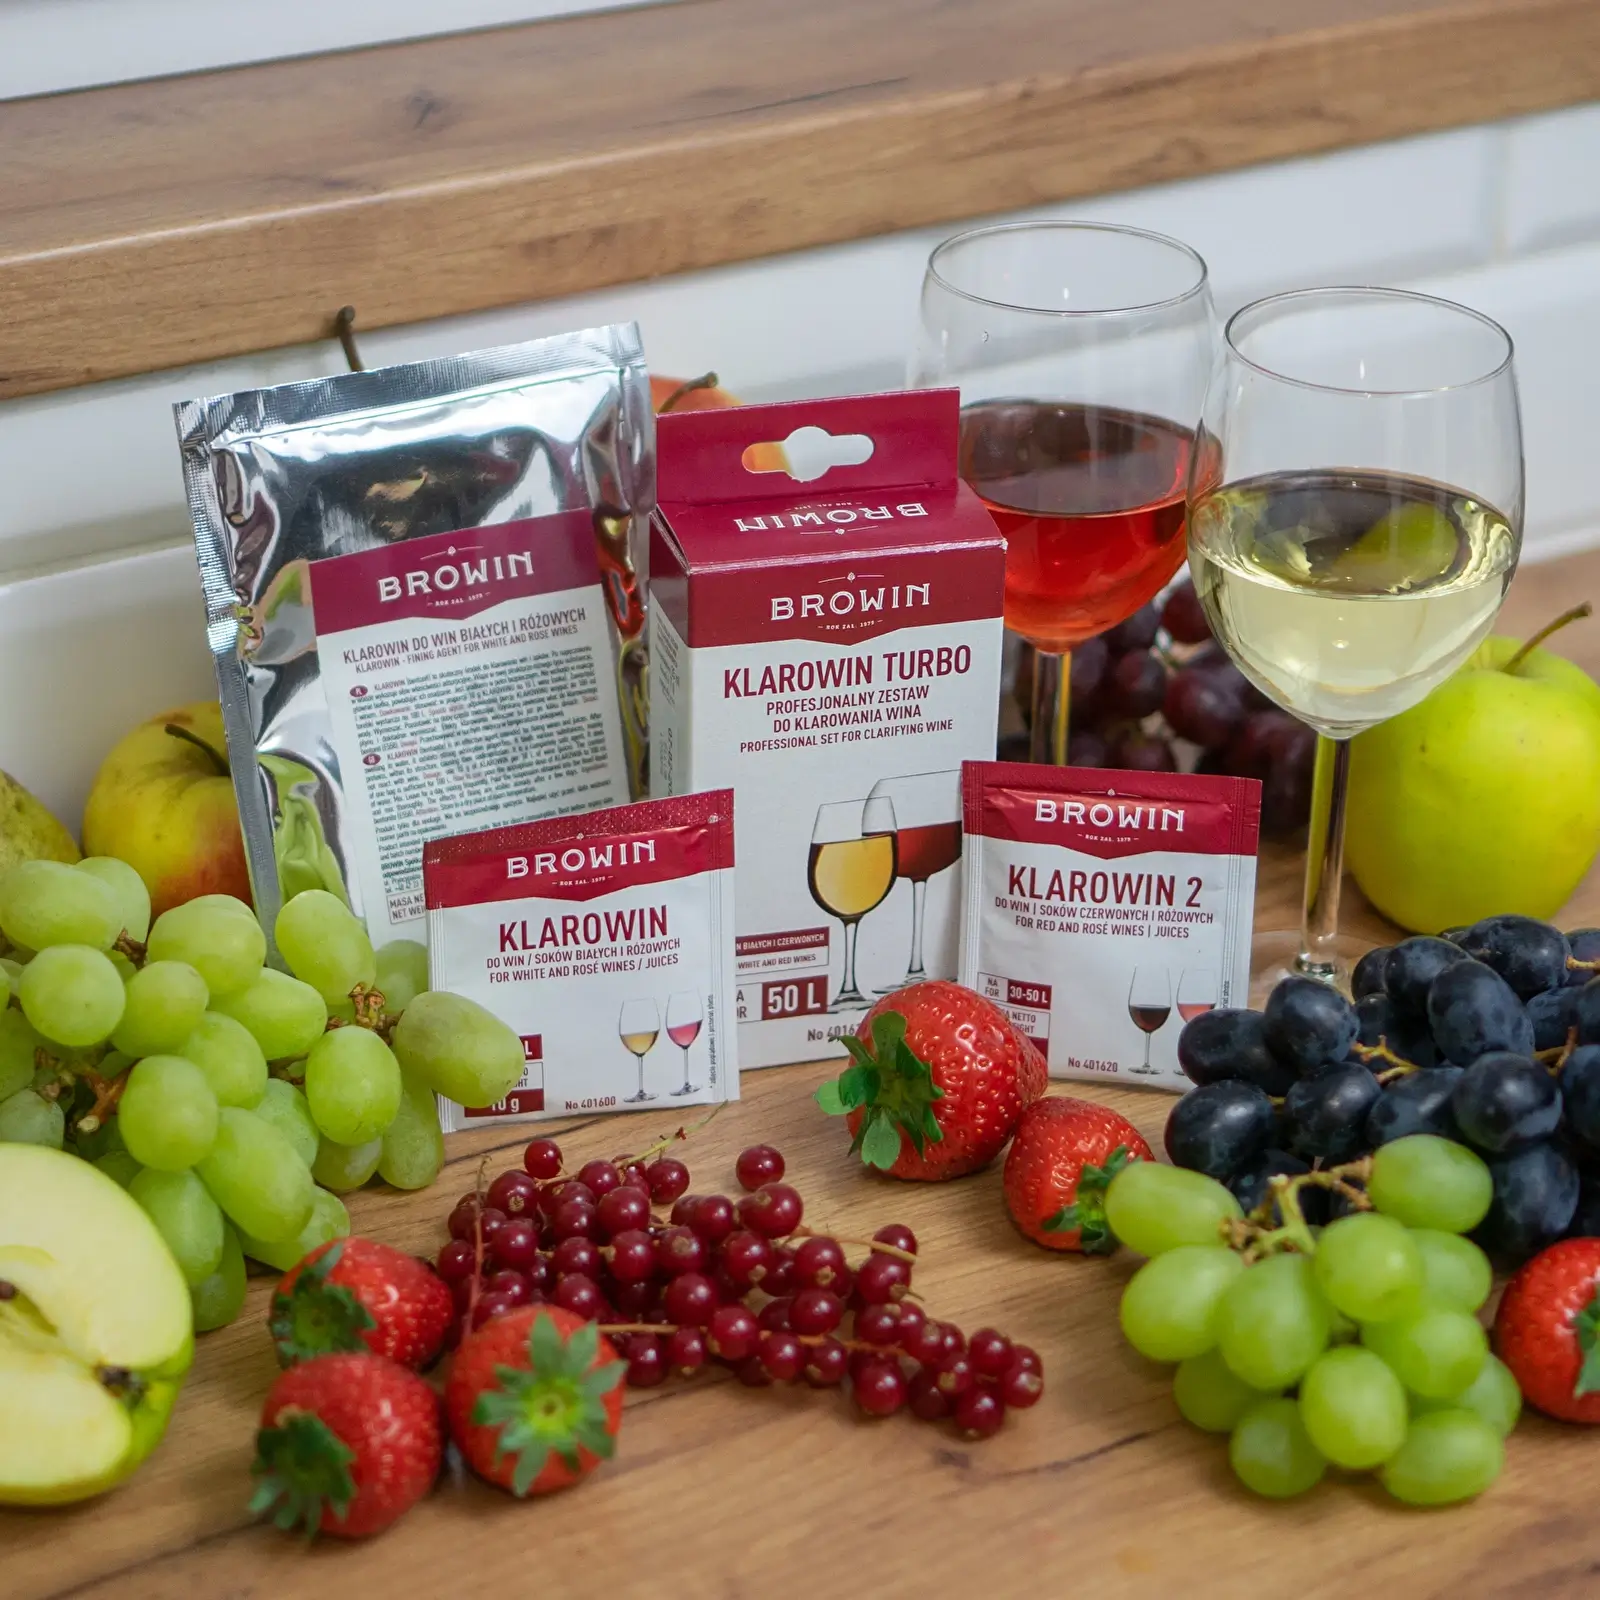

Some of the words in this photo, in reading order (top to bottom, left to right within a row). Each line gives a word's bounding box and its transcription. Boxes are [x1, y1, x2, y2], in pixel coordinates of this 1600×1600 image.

[734, 502, 928, 532] BROWIN
[378, 552, 534, 602] BROWIN
[770, 583, 930, 621] BROWIN
[344, 640, 409, 664] KLAROWIN
[412, 636, 428, 651] DO
[431, 631, 456, 647] WIN
[460, 621, 509, 643] BIAŁYCH
[512, 620, 516, 632] I
[519, 608, 586, 631] RÓŻOWYCH
[356, 656, 400, 673] KLAROWIN
[407, 650, 435, 664] FINING
[437, 644, 461, 658] AGENT
[464, 643, 480, 653] FOR
[481, 637, 509, 650] WHITE
[510, 634, 526, 644] AND
[551, 624, 578, 637] WINES
[724, 655, 873, 698] KLAROWIN
[882, 644, 972, 682] TURBO
[766, 691, 875, 715] PROFESJONALNY
[878, 685, 930, 704] ZESTAW
[773, 718, 791, 733] DO
[794, 708, 882, 732] KLAROWANIA
[886, 704, 922, 720] WINA
[740, 733, 818, 752] PROFESSIONAL
[820, 731, 838, 744] SET
[841, 730, 862, 742] FOR
[864, 722, 924, 740] CLARIFYING
[926, 719, 954, 732] WINE
[1035, 800, 1184, 832] BROWIN
[507, 840, 656, 878] BROWIN
[1008, 864, 1174, 907] KLAROWIN
[1186, 877, 1203, 908] 2
[390, 896, 412, 908] MASA
[392, 908, 406, 920] NET
[995, 897, 1008, 909] DO
[1010, 900, 1030, 912] WIN
[1040, 902, 1077, 919] SOKÓW
[1079, 907, 1149, 922] CZERWONYCH
[1157, 910, 1213, 924] RÓŻOWYCH
[499, 904, 668, 953] KLAROWIN
[743, 940, 772, 950] BIAŁYCH
[777, 933, 825, 946] CZERWONYCH
[1015, 916, 1034, 929] FOR
[1036, 918, 1056, 931] RED
[1058, 920, 1079, 933] AND
[1082, 920, 1108, 935] ROSÉ
[1110, 924, 1144, 936] WINES
[1154, 926, 1189, 938] JUICES
[486, 957, 501, 969] DO
[503, 954, 525, 967] WIN
[535, 948, 573, 964] SOKÓW
[575, 946, 618, 961] BIAŁYCH
[620, 946, 624, 957] I
[626, 938, 681, 956] RÓŻOWYCH
[738, 960, 760, 969] WHITE
[762, 958, 776, 967] AND
[778, 957, 792, 965] RED
[793, 954, 816, 963] WINES
[489, 971, 510, 984] FOR
[512, 968, 546, 982] WHITE
[548, 966, 570, 978] AND
[572, 960, 600, 976] ROSÉ
[601, 959, 636, 974] WINES
[644, 953, 679, 969] JUICES
[768, 984, 799, 1014] 50
[807, 982, 821, 1009] L
[985, 987, 1000, 997] FOR
[987, 977, 998, 987] NA
[1010, 986, 1039, 1002] 30-50
[1042, 991, 1048, 1003] L
[807, 1029, 823, 1041] No
[828, 1023, 860, 1037] 4016
[1012, 1012, 1036, 1023] NETTO
[524, 1040, 533, 1055] L
[1068, 1057, 1080, 1068] No
[1083, 1058, 1118, 1072] 401620
[511, 1098, 519, 1112] g
[565, 1100, 579, 1110] No
[581, 1096, 616, 1109] 401600
